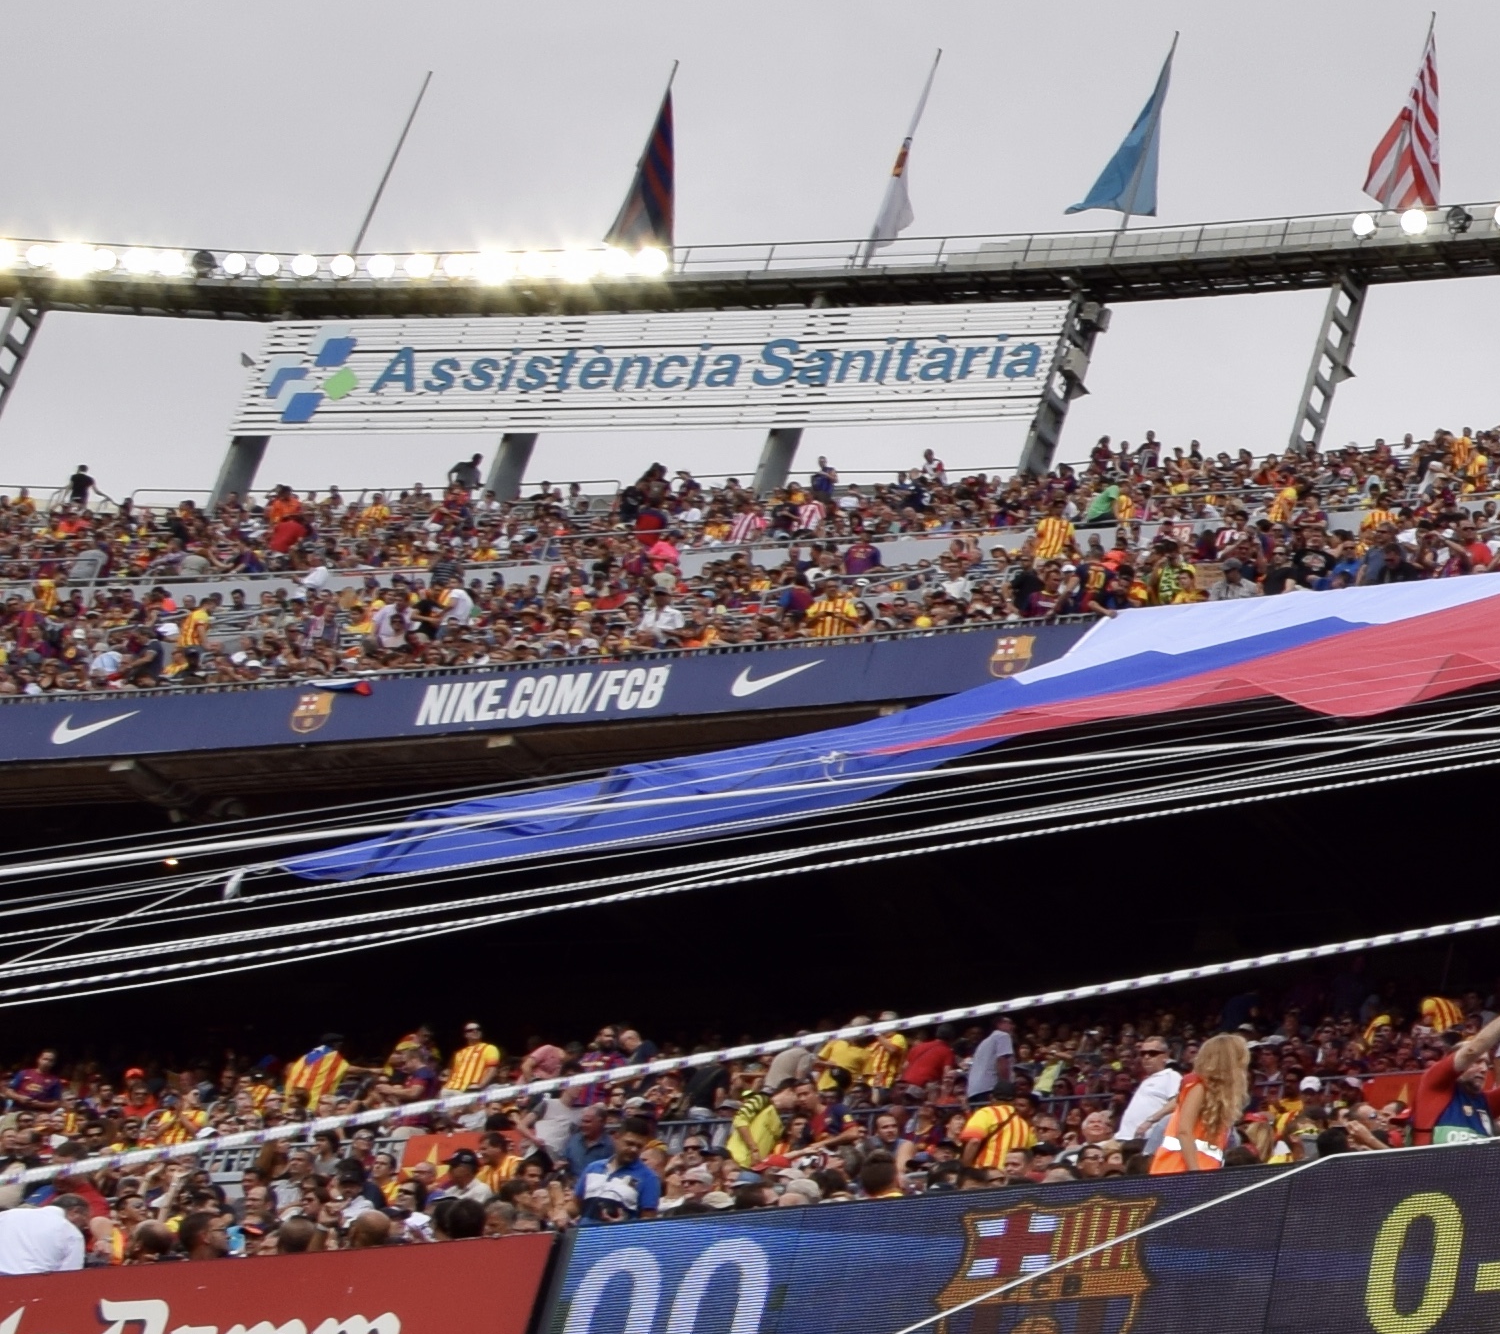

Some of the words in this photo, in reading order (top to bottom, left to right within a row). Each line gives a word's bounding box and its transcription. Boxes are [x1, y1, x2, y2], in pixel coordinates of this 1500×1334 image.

[370, 345, 741, 395] Assistència
[752, 334, 1042, 389] Sanitària
[414, 665, 668, 727] NIKE.COM/FCB
